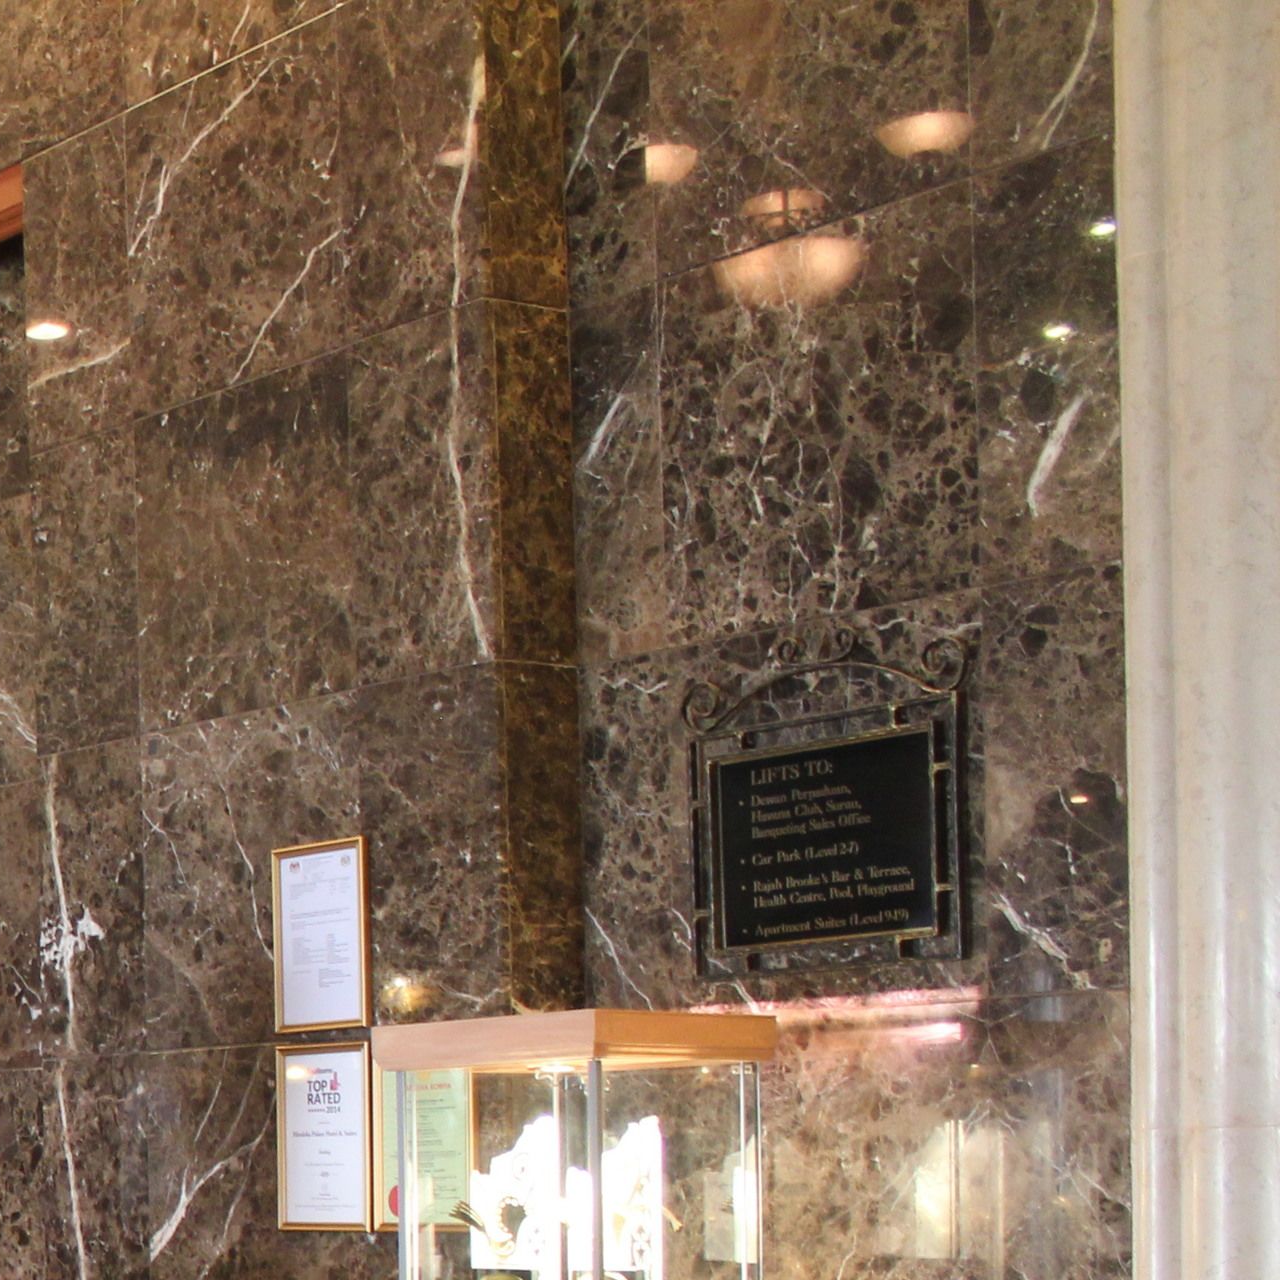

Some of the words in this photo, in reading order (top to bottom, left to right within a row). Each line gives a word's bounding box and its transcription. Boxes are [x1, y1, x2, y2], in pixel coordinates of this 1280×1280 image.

[750, 763, 800, 786] LIFTS
[804, 759, 834, 777] TO:
[809, 817, 836, 831] Sales
[838, 813, 872, 827] Office
[751, 853, 773, 866] Car
[777, 849, 801, 863] Park
[804, 843, 838, 861] (Level
[753, 878, 783, 893] Rajah
[831, 870, 851, 883] Bar
[854, 868, 864, 880] &
[753, 893, 787, 909] Health
[789, 890, 827, 904] Centre,
[857, 878, 916, 898] Playground
[755, 922, 811, 938] Apartment
[814, 916, 847, 929] Suites
[307, 1080, 328, 1093] TOP
[307, 1092, 341, 1105] RATED
